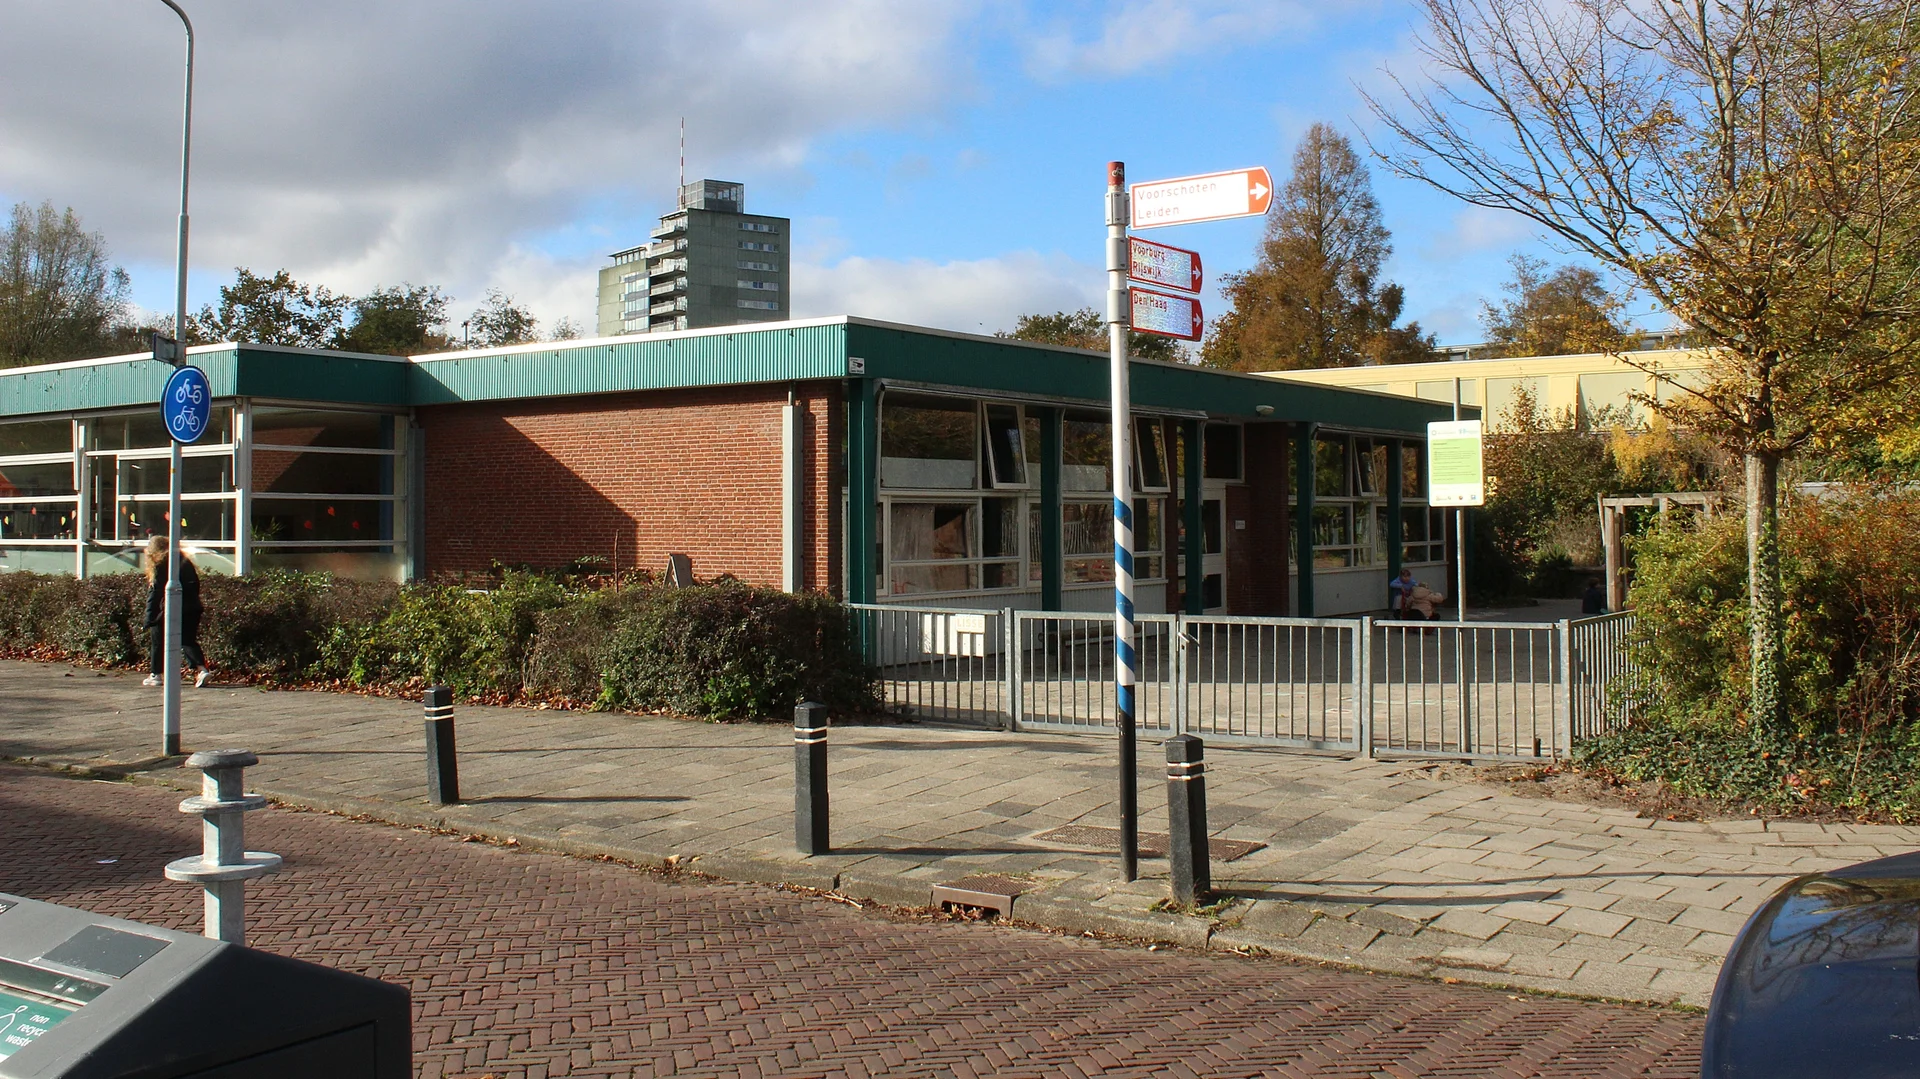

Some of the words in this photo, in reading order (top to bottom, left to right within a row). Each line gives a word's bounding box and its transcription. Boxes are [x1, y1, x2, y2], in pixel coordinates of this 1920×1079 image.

[1138, 182, 1217, 200] Voorschoten
[1138, 206, 1179, 219] Leiden
[1133, 242, 1165, 262] Voorburg
[1133, 261, 1162, 278] Rijswijk
[1134, 293, 1148, 305] Den
[1149, 296, 1167, 312] Haag
[29, 1014, 50, 1024] non
